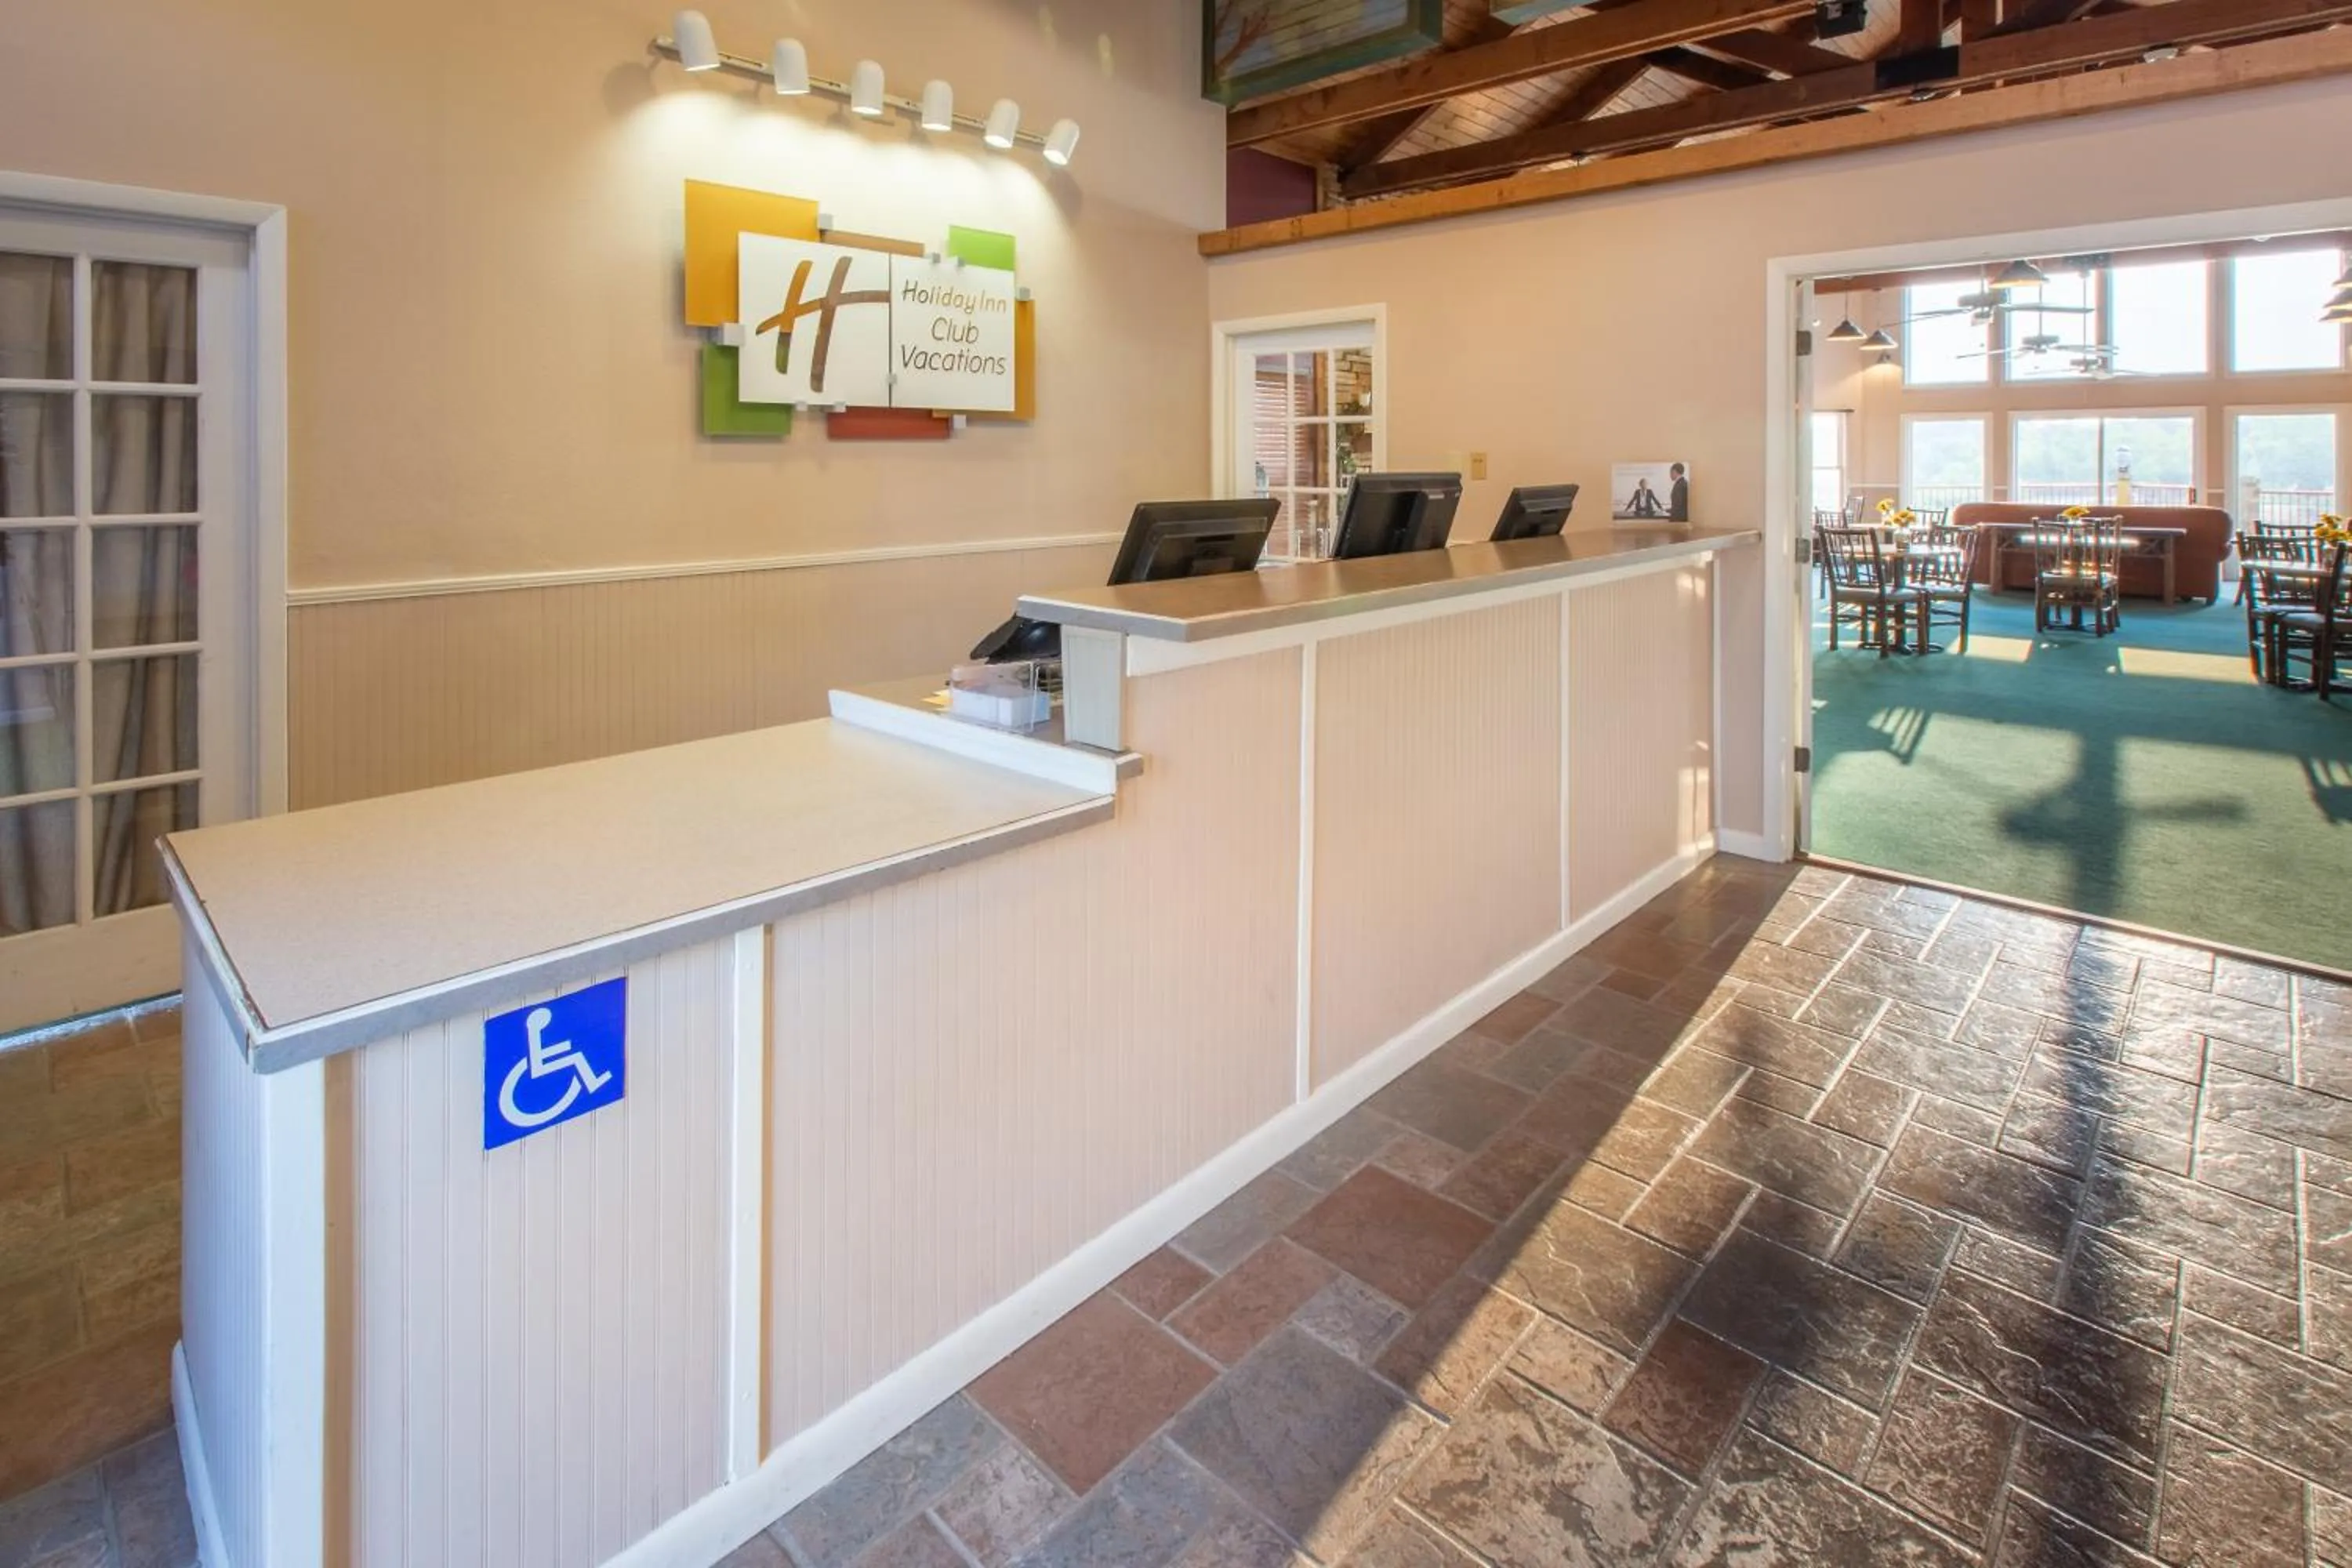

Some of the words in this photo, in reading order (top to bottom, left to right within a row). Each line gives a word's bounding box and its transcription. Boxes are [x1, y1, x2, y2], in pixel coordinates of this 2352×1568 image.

[902, 279, 976, 314] Holiday
[980, 289, 1007, 313] Inn
[931, 317, 979, 344] Club
[901, 344, 1007, 376] Vacations
